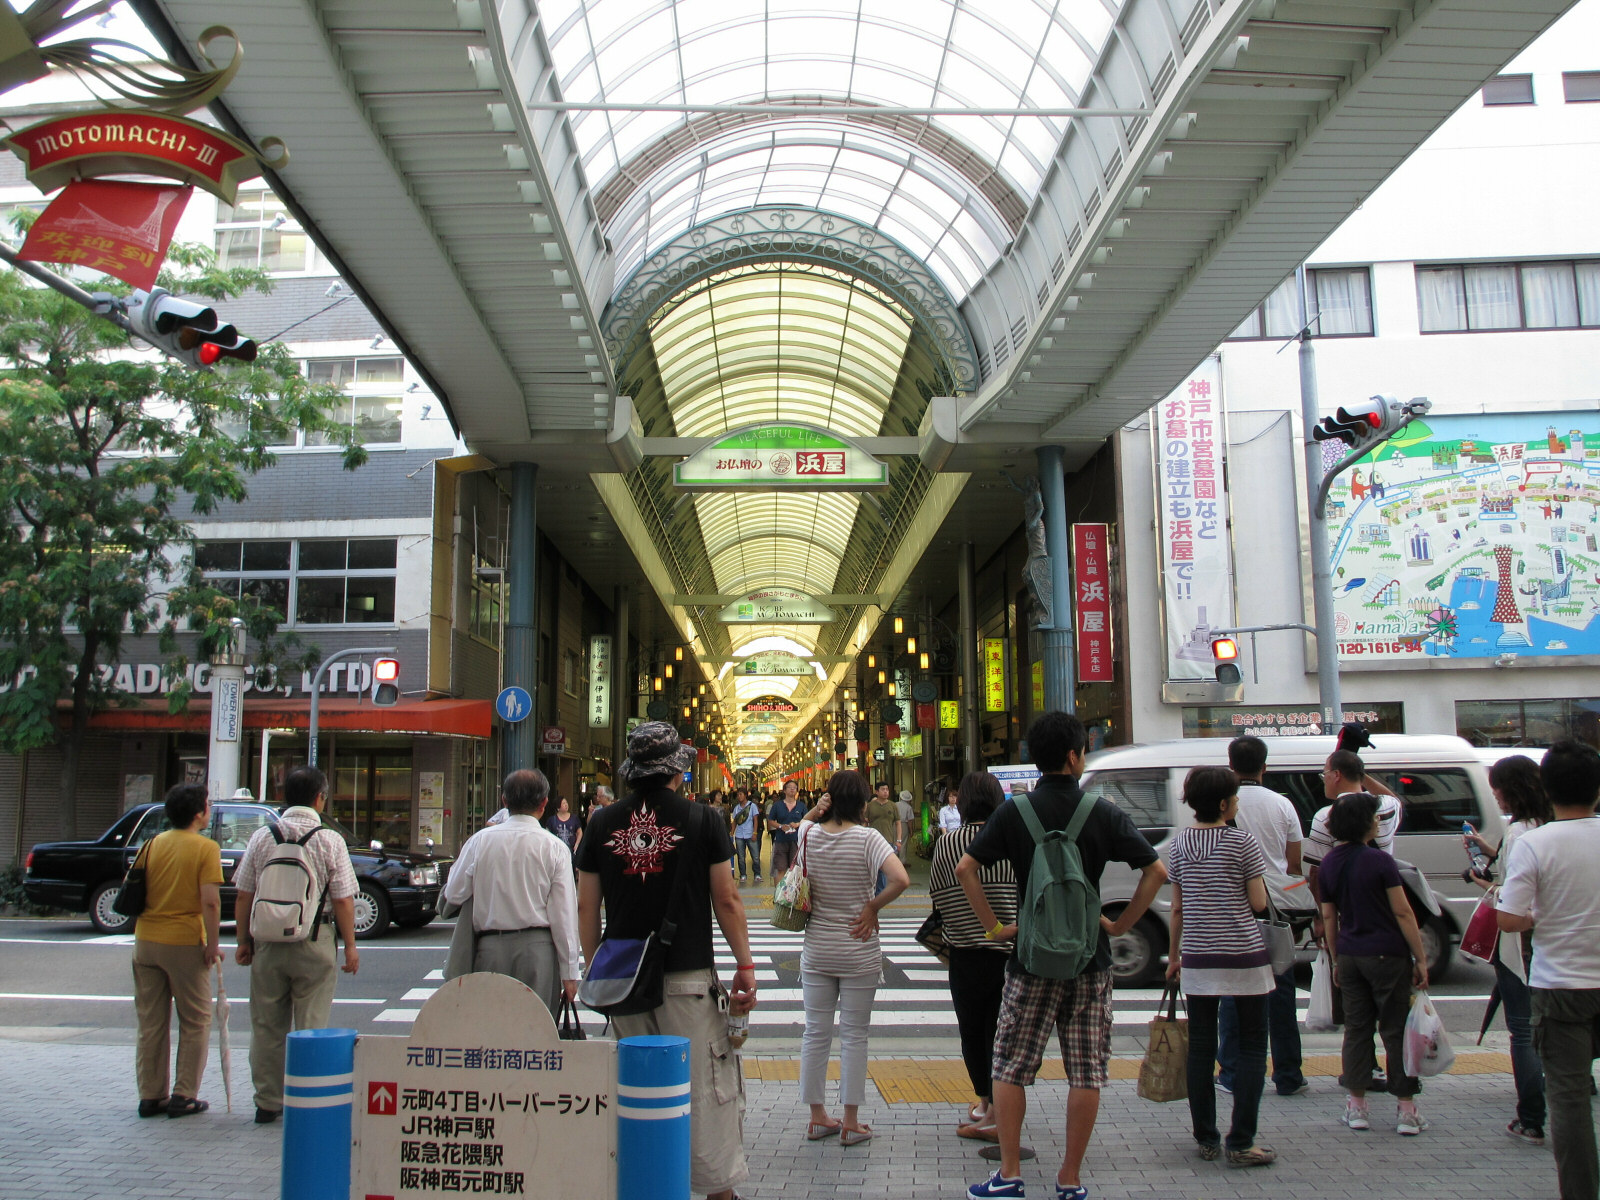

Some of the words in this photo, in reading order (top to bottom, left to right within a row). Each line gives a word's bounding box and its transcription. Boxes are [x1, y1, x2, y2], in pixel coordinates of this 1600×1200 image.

[739, 429, 793, 444] PEACEFUL
[799, 431, 822, 444] LIFE
[715, 459, 763, 471] お仏壇の
[797, 453, 844, 473] 浜屋
[1188, 379, 1217, 540] 神戸市営墓園など
[1494, 444, 1524, 461] 浜屋
[1085, 531, 1098, 576] 仏壇・仏具
[757, 610, 815, 618] MOTOMACHI
[1081, 580, 1105, 632] 浜屋
[1090, 639, 1101, 673] 神戸本店
[1336, 642, 1422, 654] 120-1616-94
[229, 683, 238, 712] TOWER
[229, 713, 238, 738] ROAD
[1152, 1028, 1174, 1053] A
[406, 1046, 564, 1071] 元町三番街商店街
[401, 1088, 608, 1116] 元町4丁目・ハーバーランド
[401, 1115, 495, 1139] JR神戸駅
[400, 1141, 504, 1167] 阪急花隈駅
[399, 1168, 525, 1194] 阪神西元町駅
